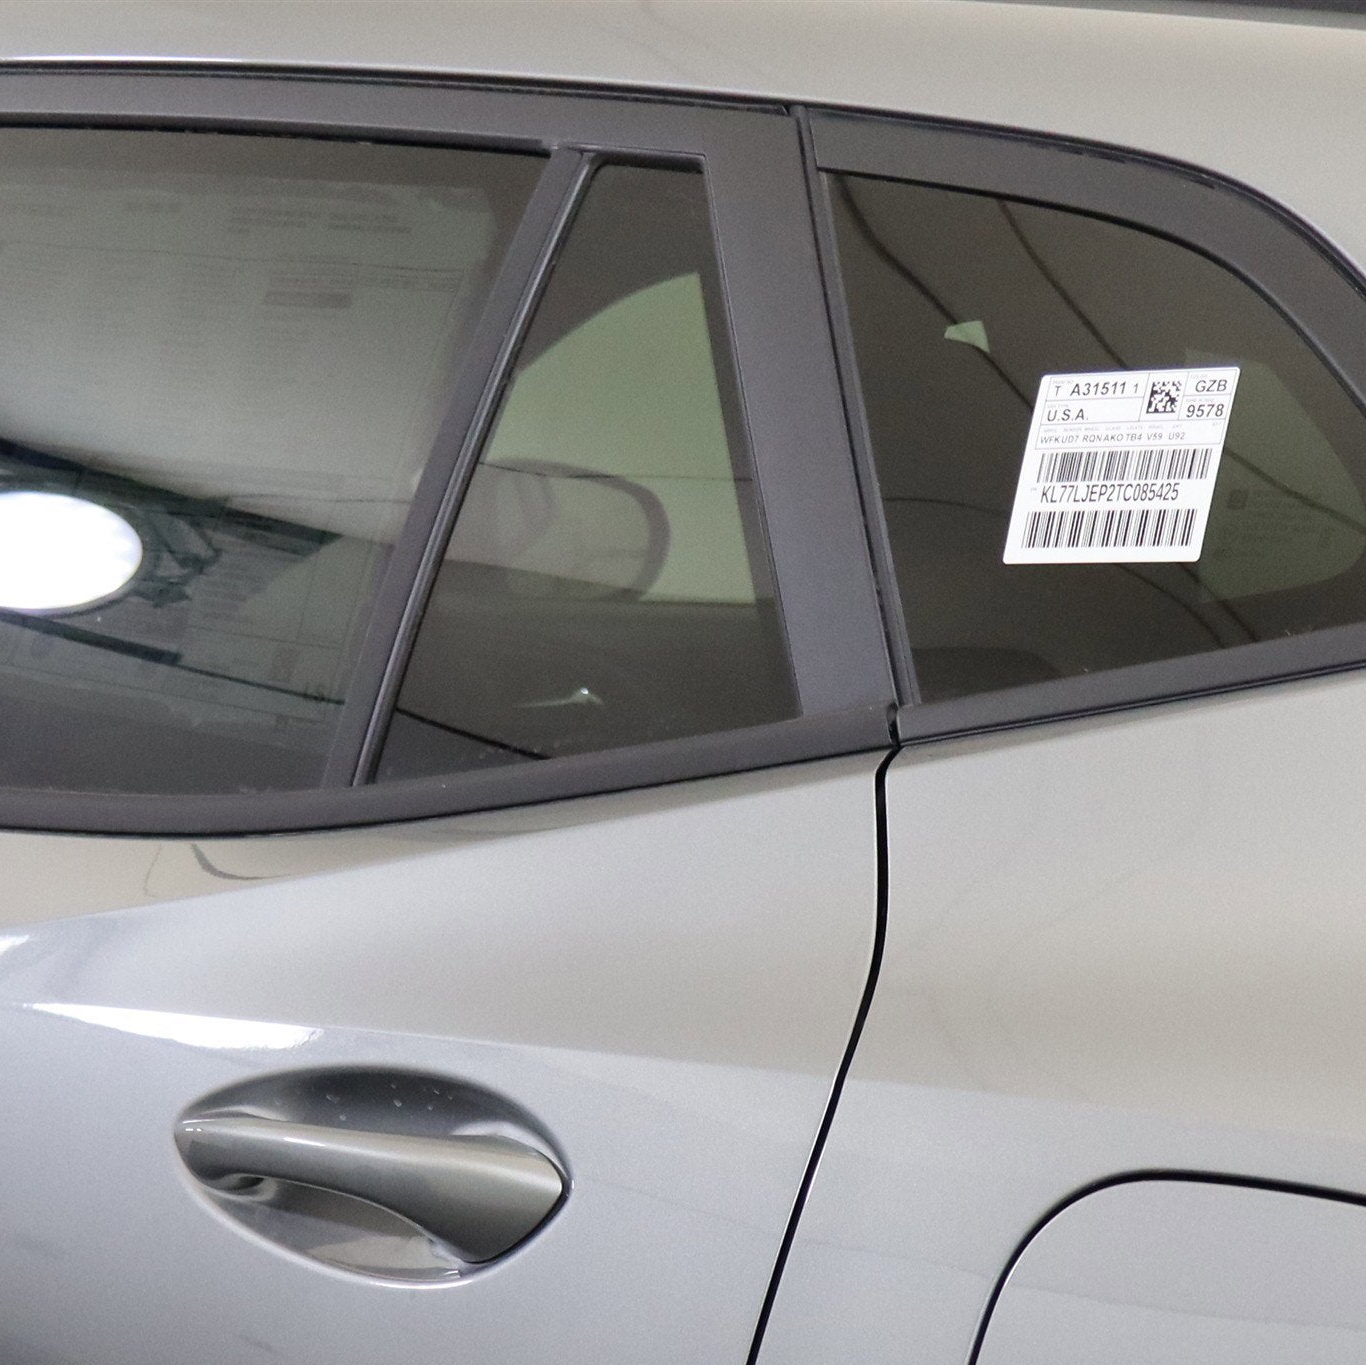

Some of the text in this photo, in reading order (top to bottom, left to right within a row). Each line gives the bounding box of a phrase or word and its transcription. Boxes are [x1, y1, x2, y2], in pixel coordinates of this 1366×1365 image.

[1055, 385, 1061, 396] T
[1070, 381, 1126, 396] A31511
[1195, 379, 1227, 392] GZB
[1047, 408, 1089, 422] U.S.A.
[1186, 403, 1224, 418] 9578
[1040, 482, 1180, 503] KL77LJEP2TC085425
